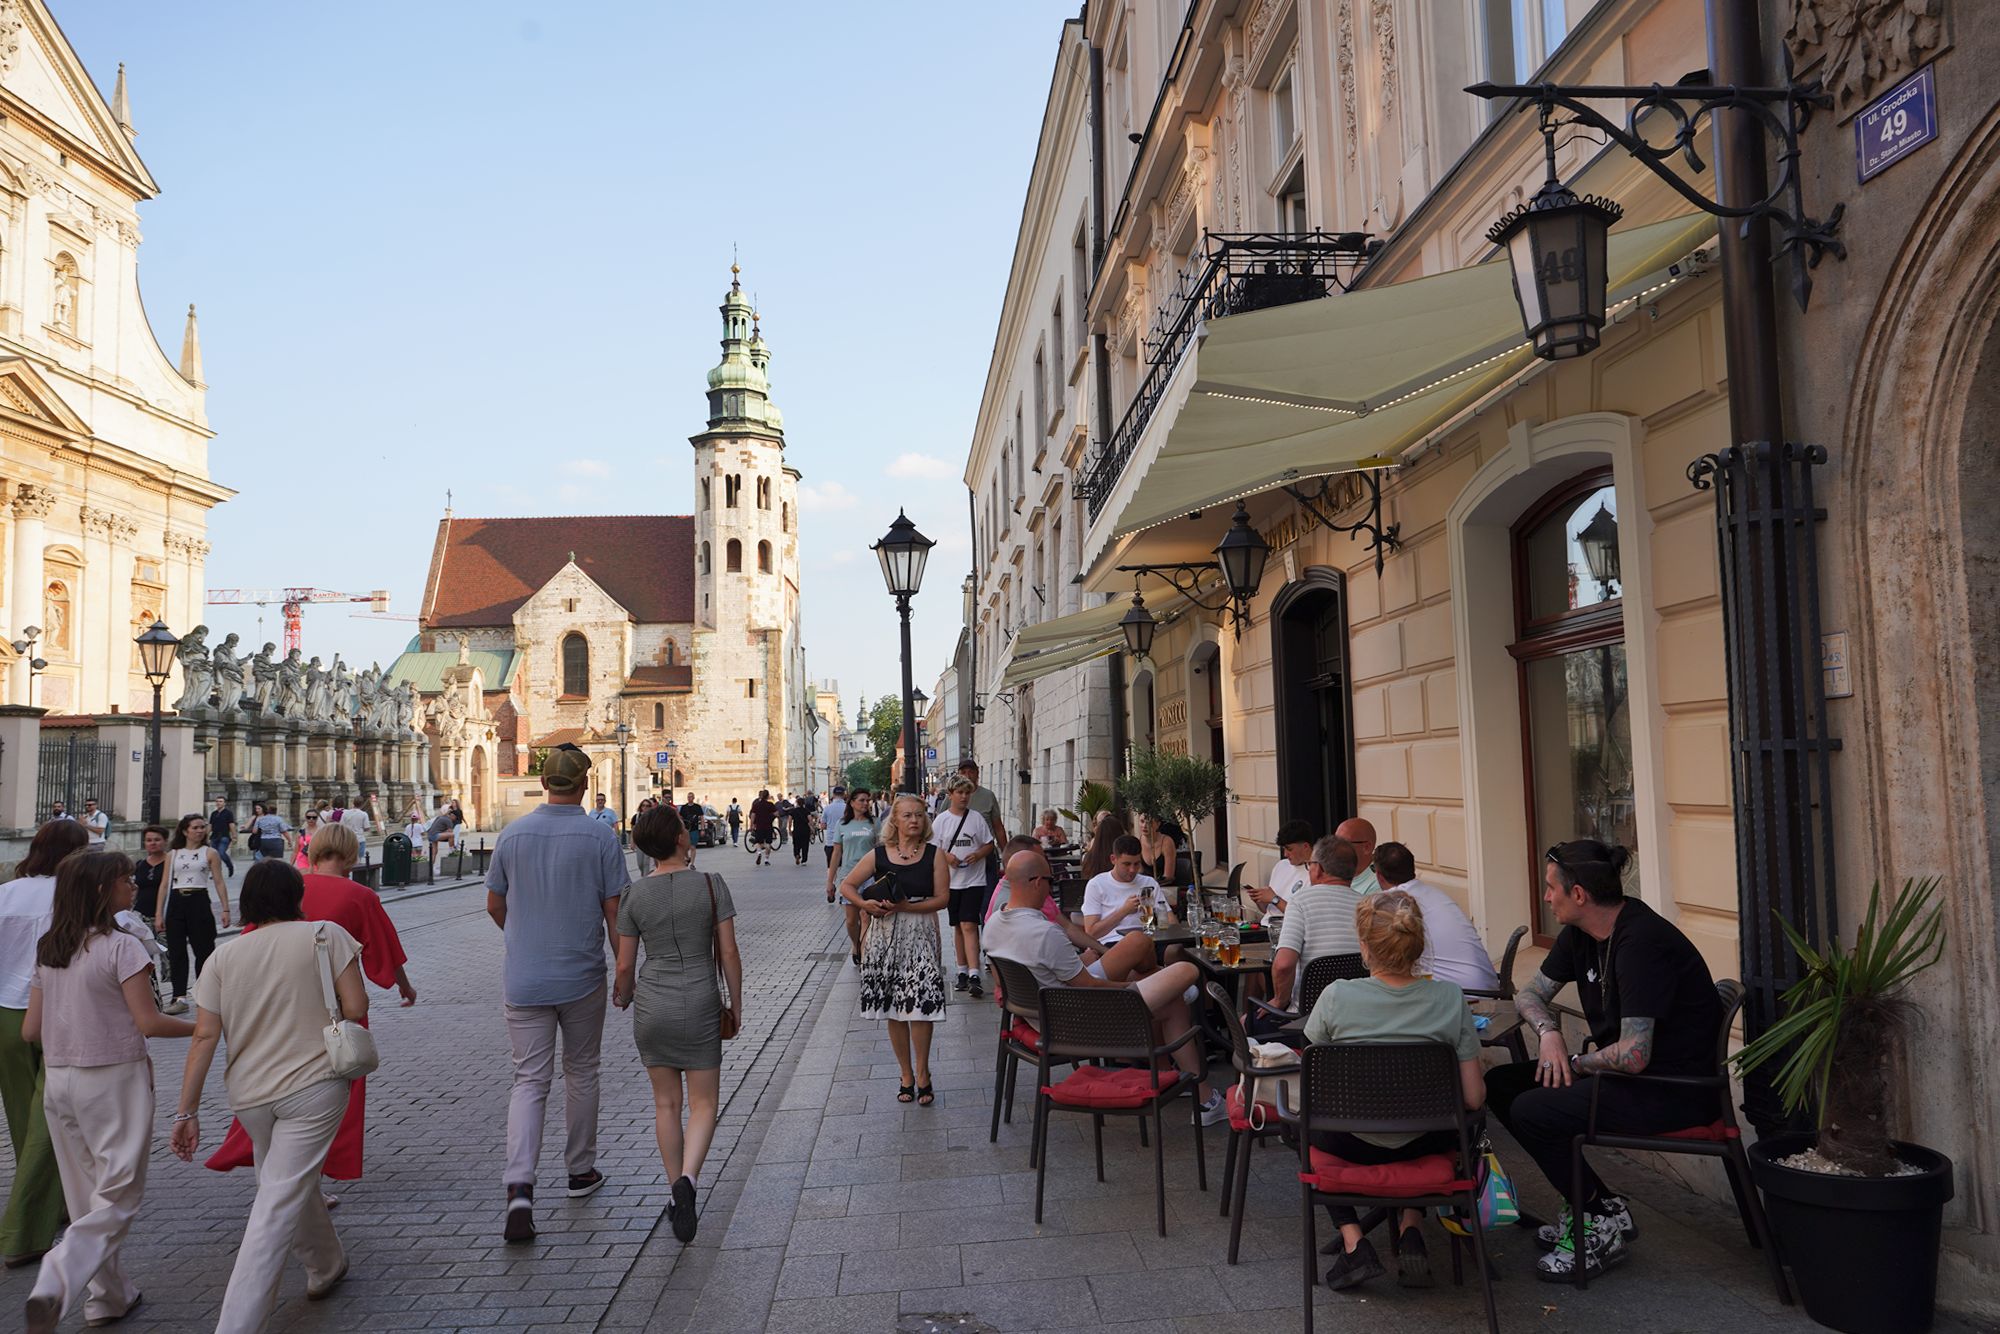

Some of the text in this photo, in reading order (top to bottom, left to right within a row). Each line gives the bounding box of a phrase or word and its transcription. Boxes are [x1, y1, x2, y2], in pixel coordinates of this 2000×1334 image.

[1881, 87, 1917, 116] Grodzka
[1880, 109, 1907, 142] 49
[1881, 145, 1898, 160] Stare
[1899, 129, 1922, 148] Miasto
[1539, 247, 1580, 285] 49
[658, 753, 666, 762] P
